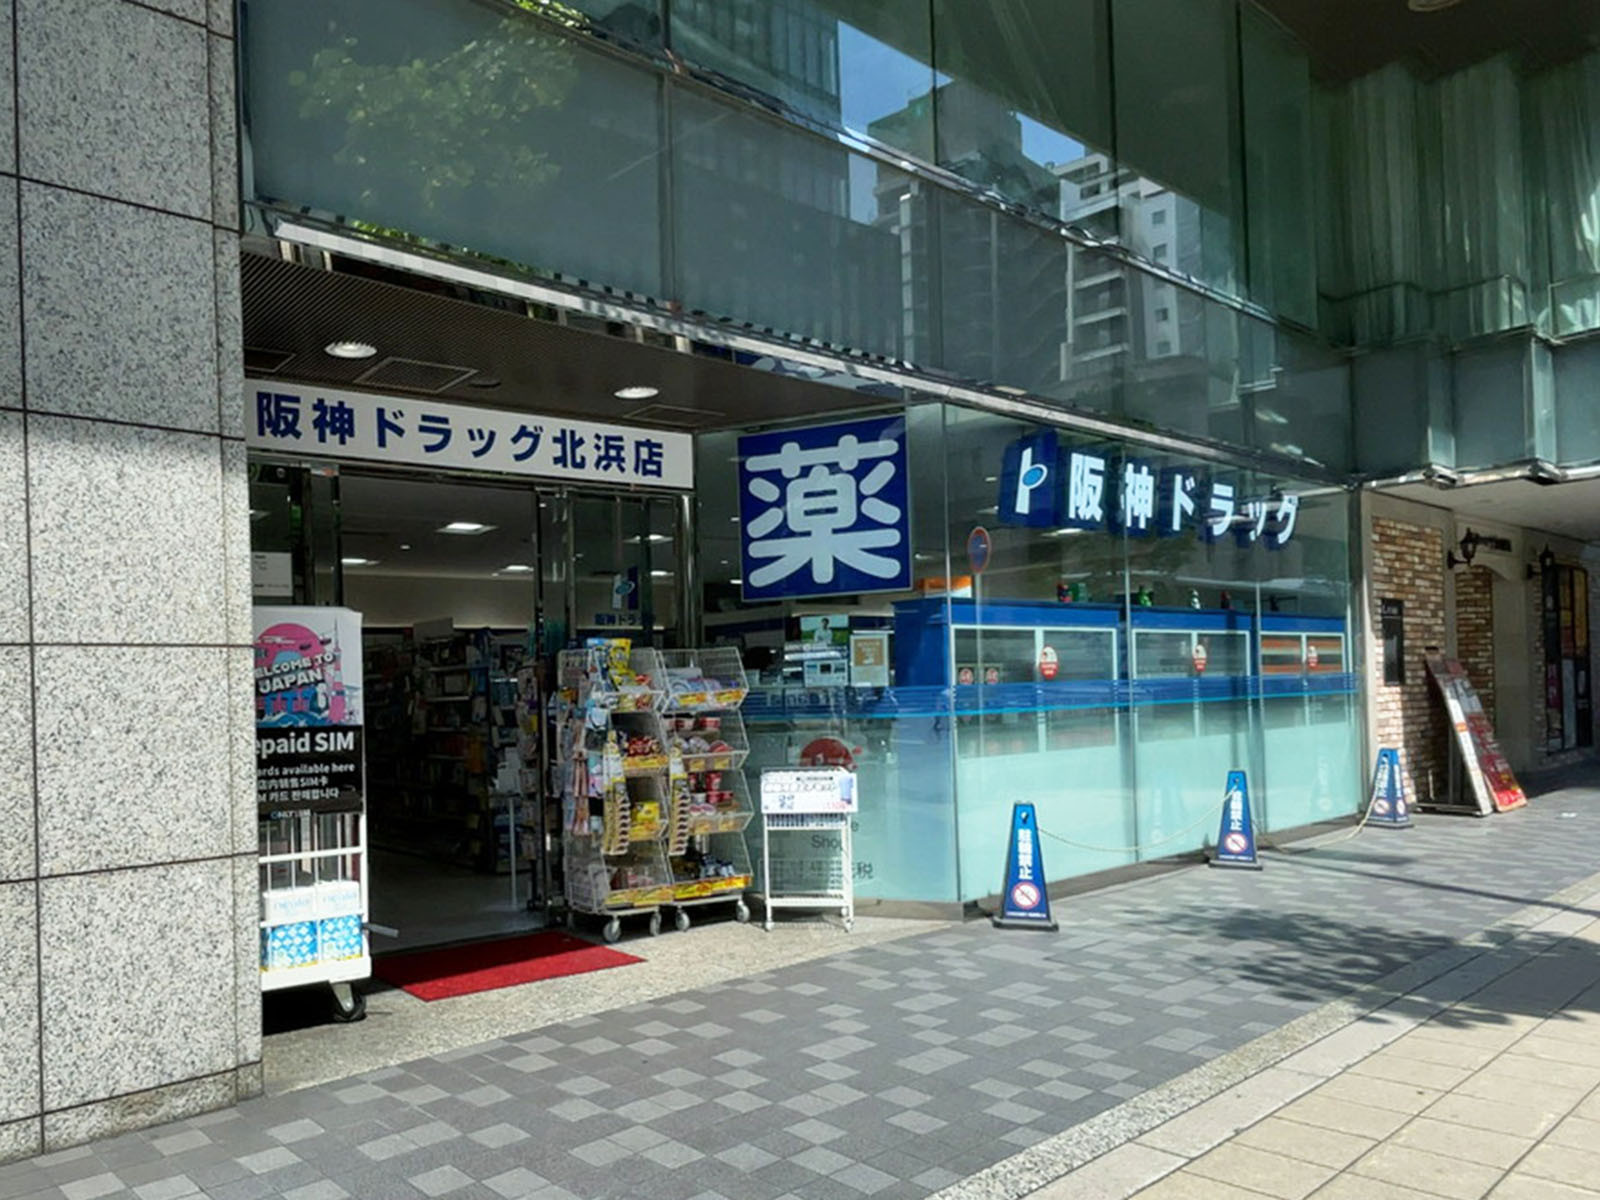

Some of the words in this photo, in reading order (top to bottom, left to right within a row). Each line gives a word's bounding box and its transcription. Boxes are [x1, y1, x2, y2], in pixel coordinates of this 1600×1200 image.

[256, 391, 664, 478] 阪神ドラッグ北浜店
[745, 434, 901, 588] 薬
[1069, 452, 1299, 545] 阪神ドラッグ
[314, 652, 334, 664] TO
[259, 668, 323, 694] JAPAN
[315, 731, 355, 752] SIM
[282, 763, 330, 775] available
[331, 762, 355, 773] here
